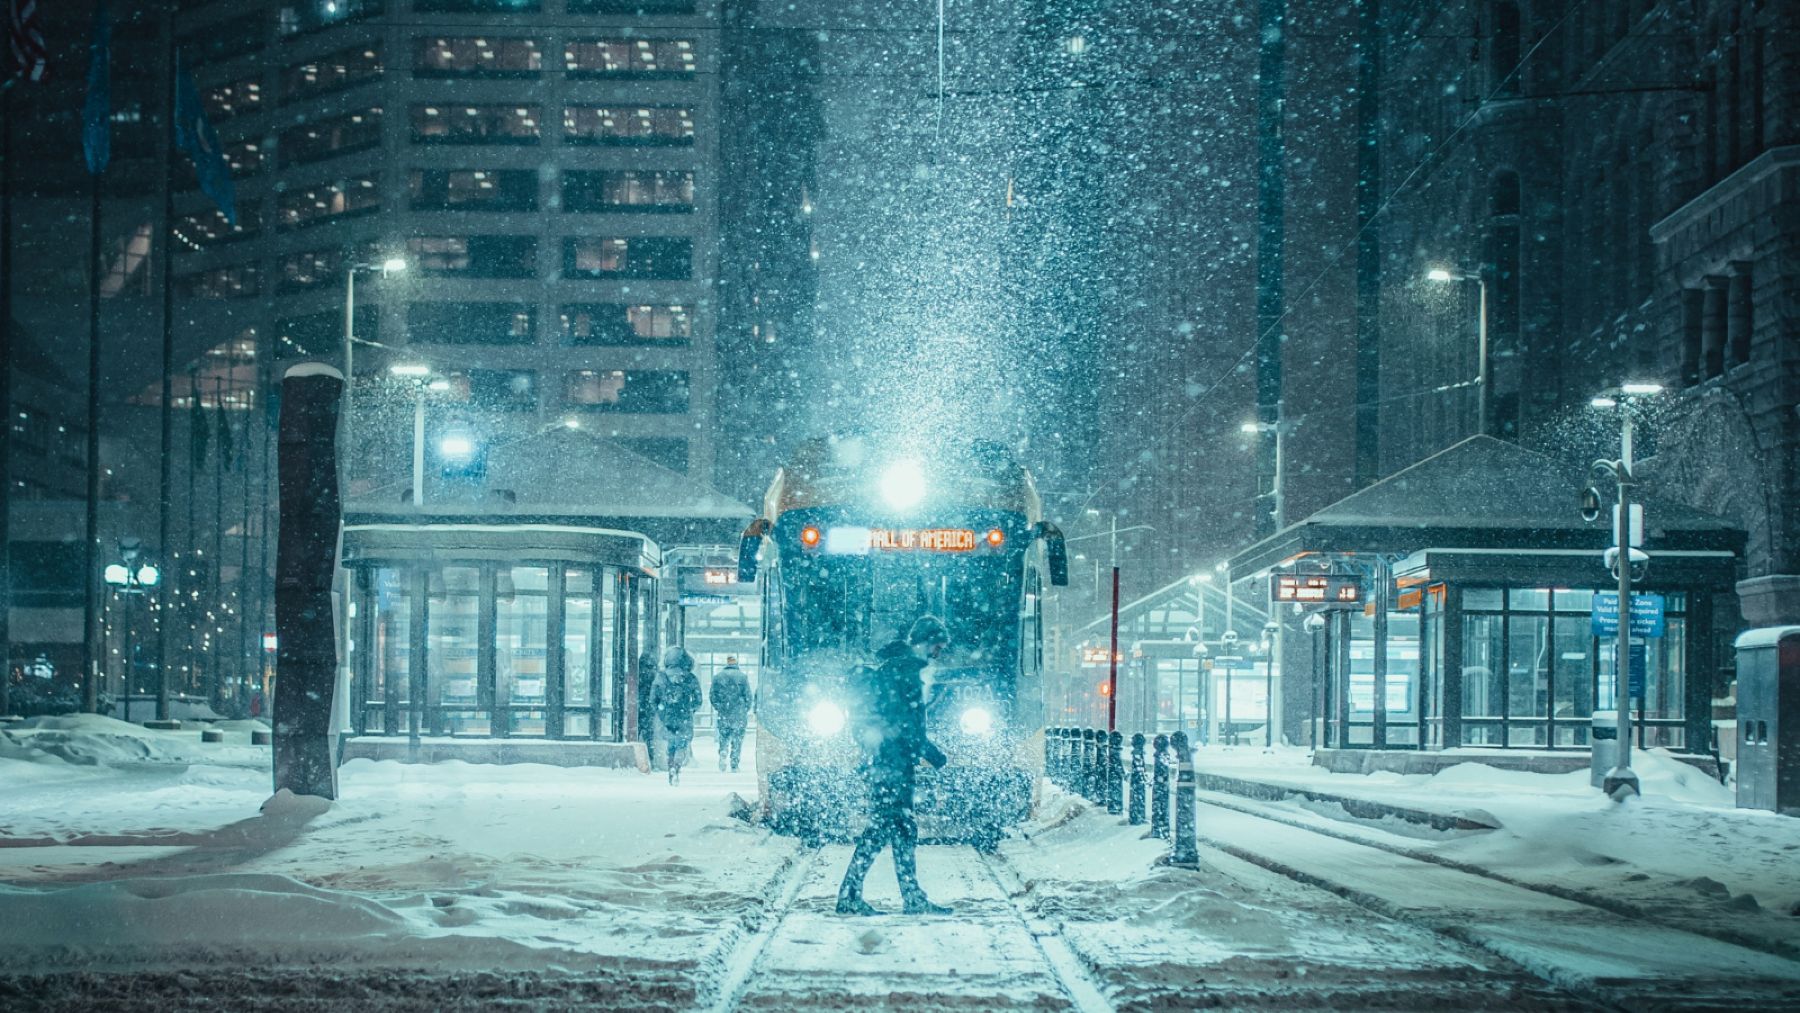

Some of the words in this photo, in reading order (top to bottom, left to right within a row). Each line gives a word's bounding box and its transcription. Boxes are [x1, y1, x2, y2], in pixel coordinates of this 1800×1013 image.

[870, 529, 899, 548] MALL
[902, 529, 916, 548] OF
[919, 529, 974, 549] AMERICA
[1635, 598, 1652, 606] Zone
